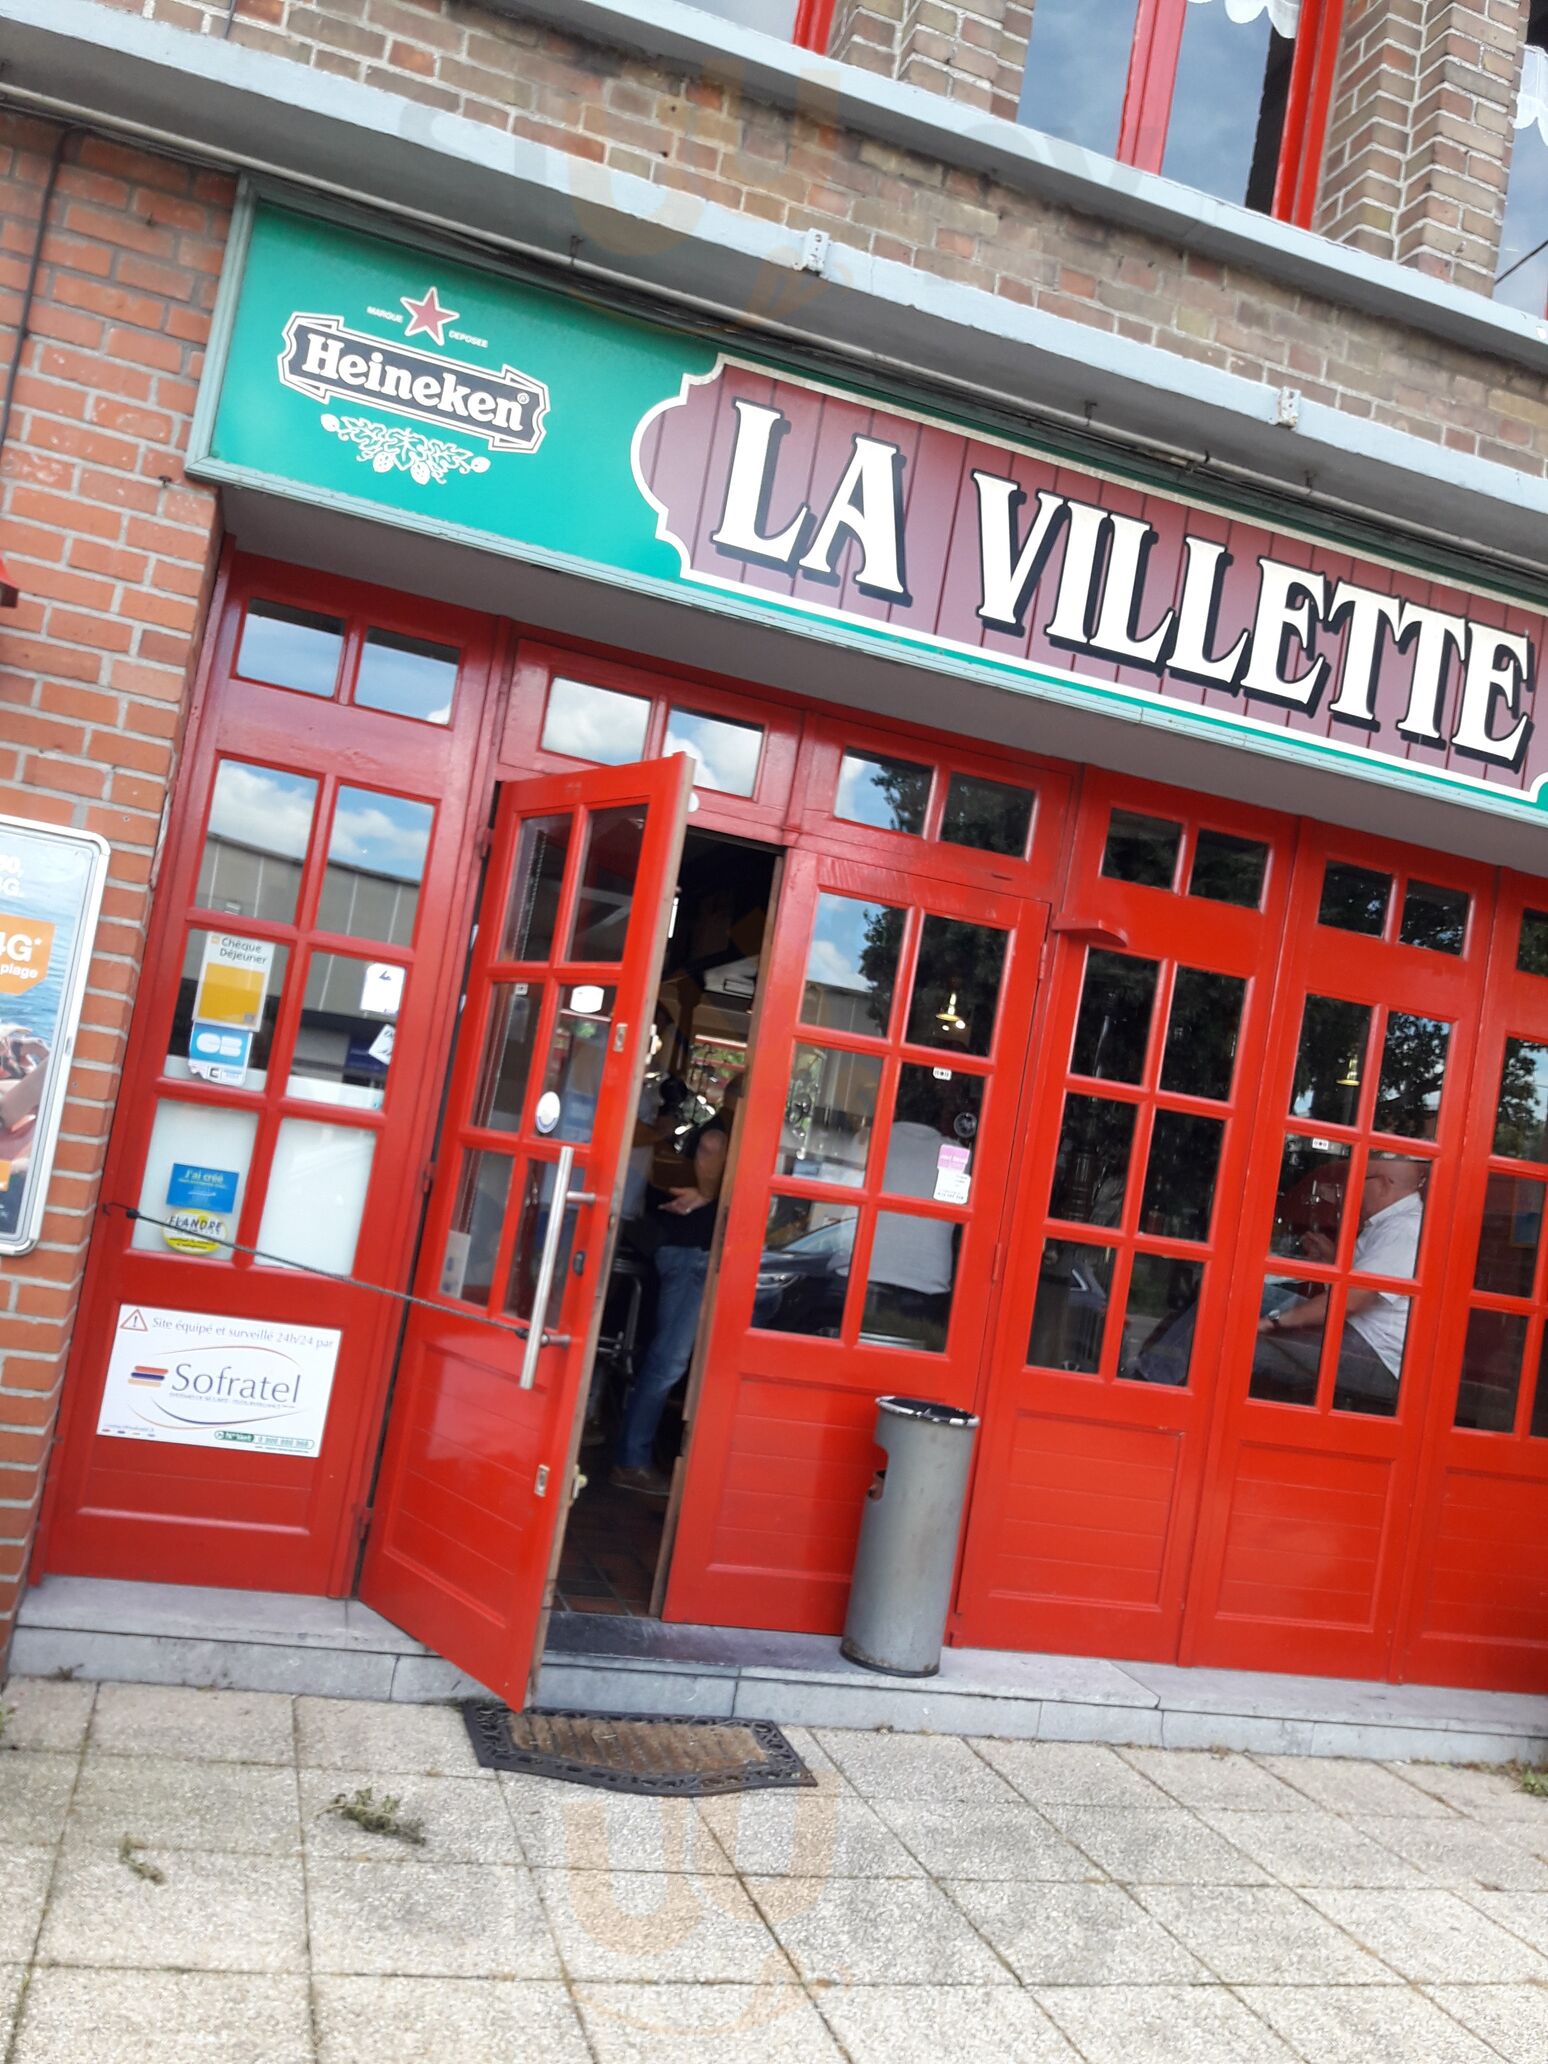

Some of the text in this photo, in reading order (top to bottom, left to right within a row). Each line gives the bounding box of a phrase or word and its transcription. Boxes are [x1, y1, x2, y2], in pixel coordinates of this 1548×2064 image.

[366, 305, 489, 348] MARQUE DEPOSEE
[302, 333, 524, 431] Heineken
[713, 399, 1534, 770] LA VILLETTE
[219, 947, 267, 965] Déjeuner
[168, 1215, 223, 1233] FLANDRE
[152, 1317, 334, 1351] Site équipé et surveillé 24h/24 par
[171, 1362, 301, 1404] Sofratel
